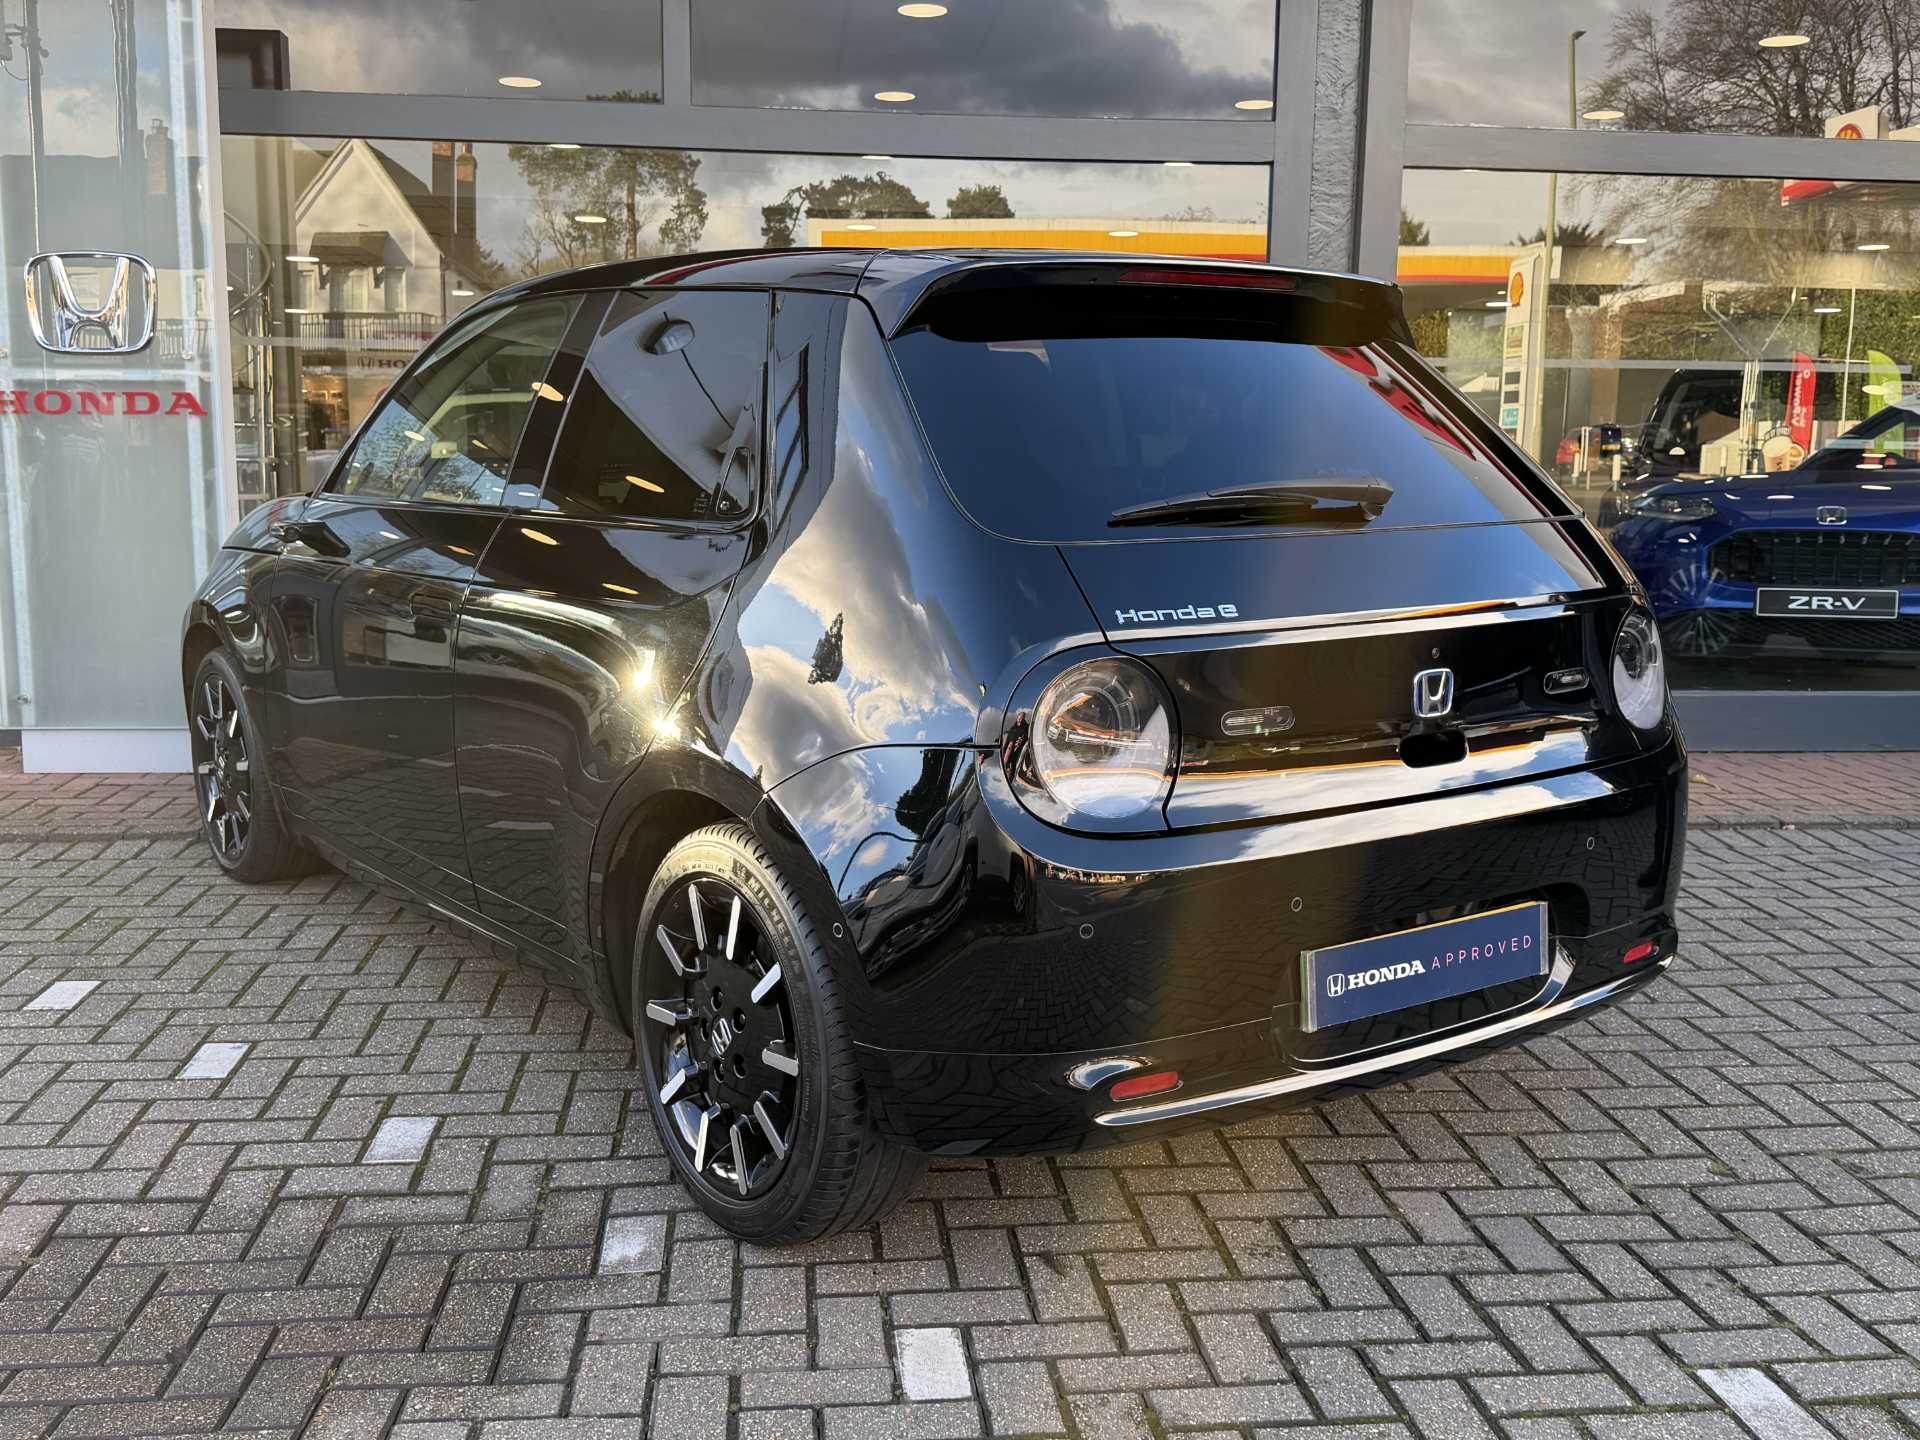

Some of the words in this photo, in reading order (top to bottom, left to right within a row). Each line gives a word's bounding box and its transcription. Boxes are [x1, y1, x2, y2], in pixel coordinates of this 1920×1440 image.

[0, 390, 208, 416] HONDA
[1115, 605, 1216, 624] Honda
[1218, 604, 1239, 617] e
[1788, 596, 1866, 610] ZR-V
[1347, 960, 1426, 989] HONDA
[1432, 935, 1532, 970] APPROVED
